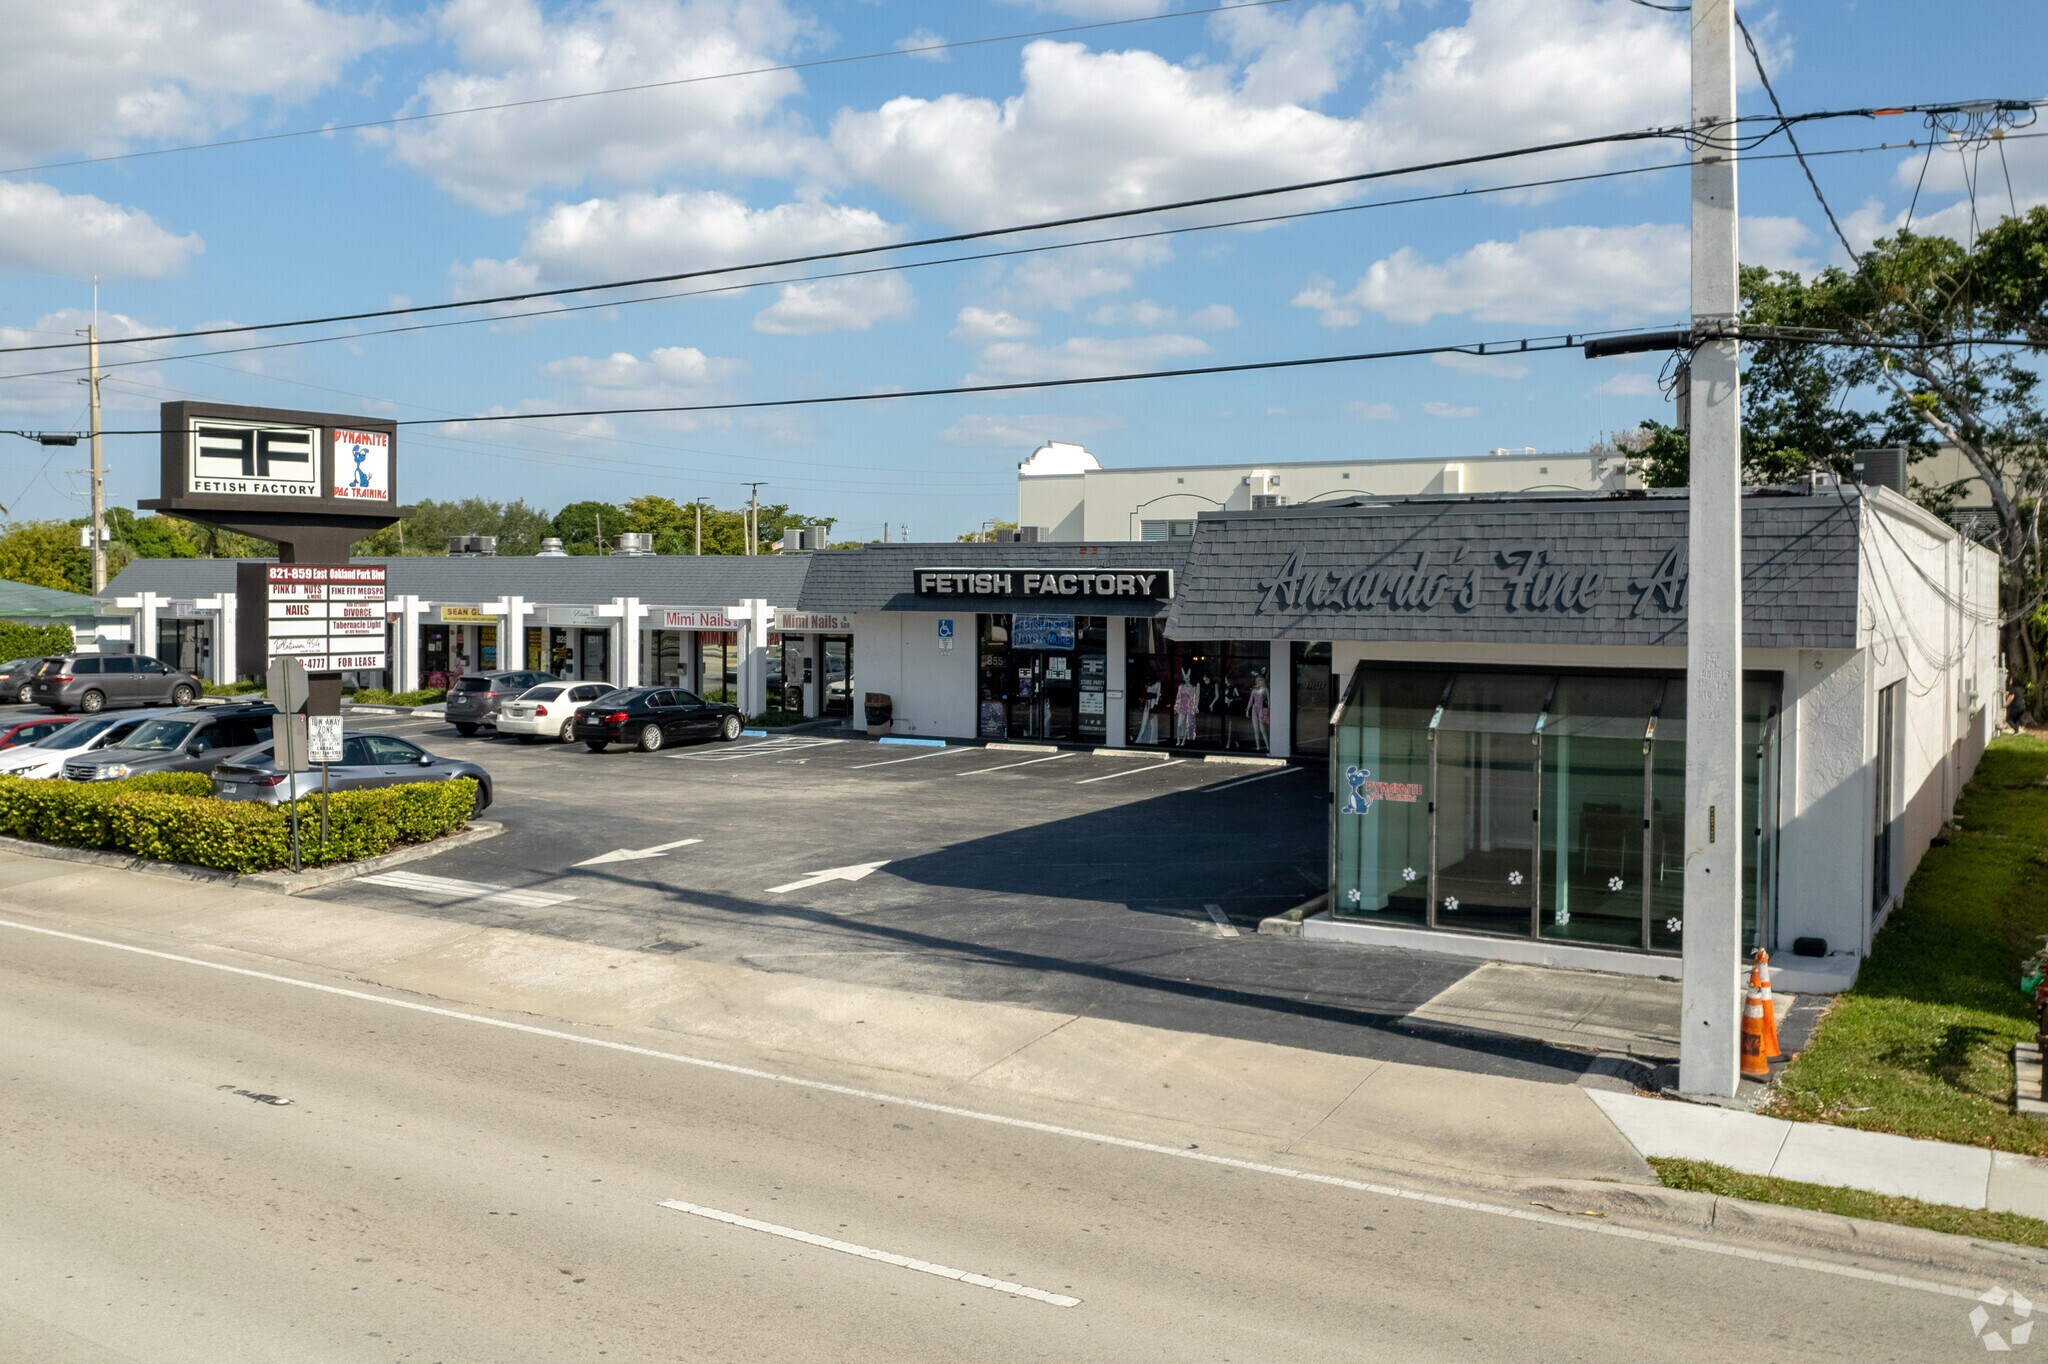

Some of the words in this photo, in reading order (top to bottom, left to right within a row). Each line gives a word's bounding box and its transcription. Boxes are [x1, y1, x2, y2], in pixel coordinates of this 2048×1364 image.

[334, 430, 387, 447] DYNAMITE
[195, 481, 247, 492] FETISH
[254, 483, 315, 495] FACTORY
[351, 487, 387, 499] TRAINING
[270, 567, 313, 579] 821-859
[313, 568, 328, 580] East
[330, 568, 356, 580] Oakland
[356, 569, 371, 580] Park
[371, 569, 385, 580] Blvd
[1497, 543, 1607, 611] Fine
[1631, 542, 1689, 615] A
[273, 584, 290, 594] PINK
[303, 584, 322, 594] NUTS
[920, 573, 1012, 594] FETISH
[1023, 573, 1157, 595] FACTORY
[331, 587, 345, 595] FINE
[346, 587, 356, 595] FIT
[357, 587, 384, 595] MEDSPA
[285, 604, 310, 616] NAILS
[343, 608, 372, 617] DIVORCE
[447, 608, 469, 616] SEAN
[333, 621, 366, 629] Tabernacle
[367, 621, 382, 630] Light
[666, 612, 695, 626] Mimi
[700, 612, 731, 627] Nails
[782, 614, 809, 629] Mimi
[811, 614, 838, 629] Nails
[338, 657, 353, 667] FOR
[355, 656, 376, 667] LEASE
[324, 717, 341, 726] AWAY
[1365, 780, 1423, 796] DYNAMITE
